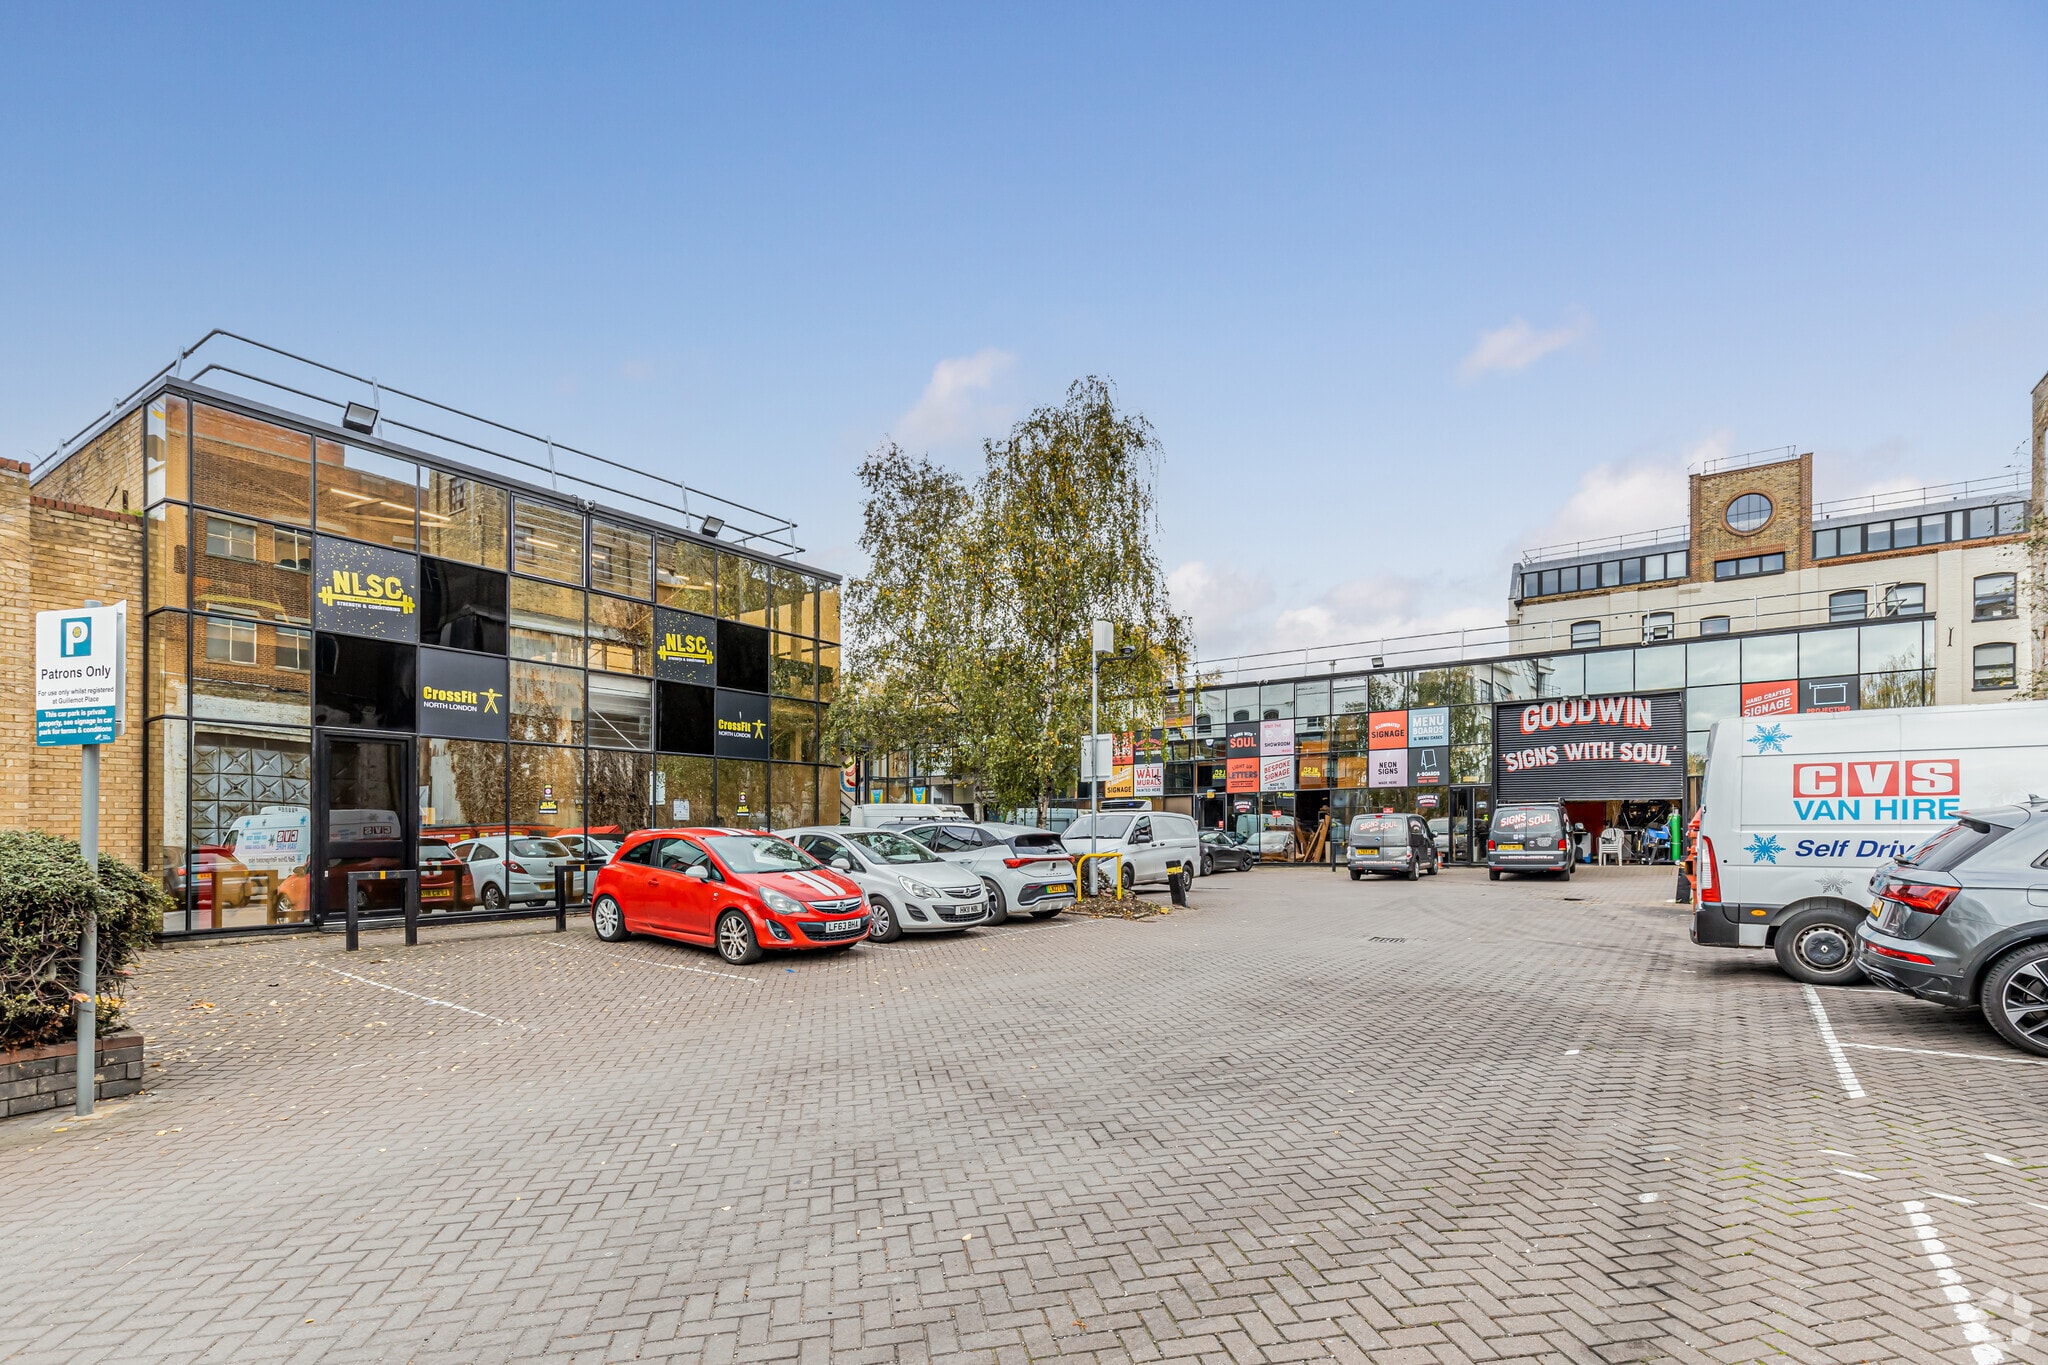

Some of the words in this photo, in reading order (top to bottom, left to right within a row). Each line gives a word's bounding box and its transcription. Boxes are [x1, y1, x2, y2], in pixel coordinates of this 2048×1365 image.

[333, 570, 402, 599] NLSC
[666, 633, 706, 654] NLSC
[42, 669, 82, 680] Patrons
[86, 665, 111, 678] Only
[88, 686, 114, 694] registered
[423, 686, 477, 704] CrossFit
[1746, 696, 1762, 704] HAND
[1764, 688, 1790, 699] CRAFTED
[449, 704, 477, 712] LONDON
[1744, 698, 1790, 717] SIGNAGE
[1412, 716, 1444, 727] MENU
[1520, 696, 1652, 734] GOODWIN
[718, 719, 751, 733] CrossFit
[1412, 726, 1444, 734] BOARDS
[1372, 730, 1404, 738] SIGNAGE
[1230, 737, 1256, 748] SOUL
[1505, 746, 1559, 772] SIGNS
[1563, 742, 1614, 761] WITH
[1620, 743, 1672, 766] SOUL
[1136, 769, 1161, 778] WALL
[1264, 760, 1290, 773] BESPOKE
[1228, 771, 1258, 779] LETTERS
[1264, 768, 1290, 781] SIGNAGE
[1797, 762, 1955, 796] CVS
[1794, 800, 1860, 820] VAN
[1874, 799, 1960, 820] HIRE
[1360, 820, 1379, 831] SIGNS
[1380, 820, 1397, 830] SOUL
[1500, 813, 1526, 828] SIGNS
[1528, 814, 1552, 826] SOUL
[1795, 840, 1850, 858] Self
[1856, 840, 1915, 858] Driv
[829, 921, 847, 931] LF63
